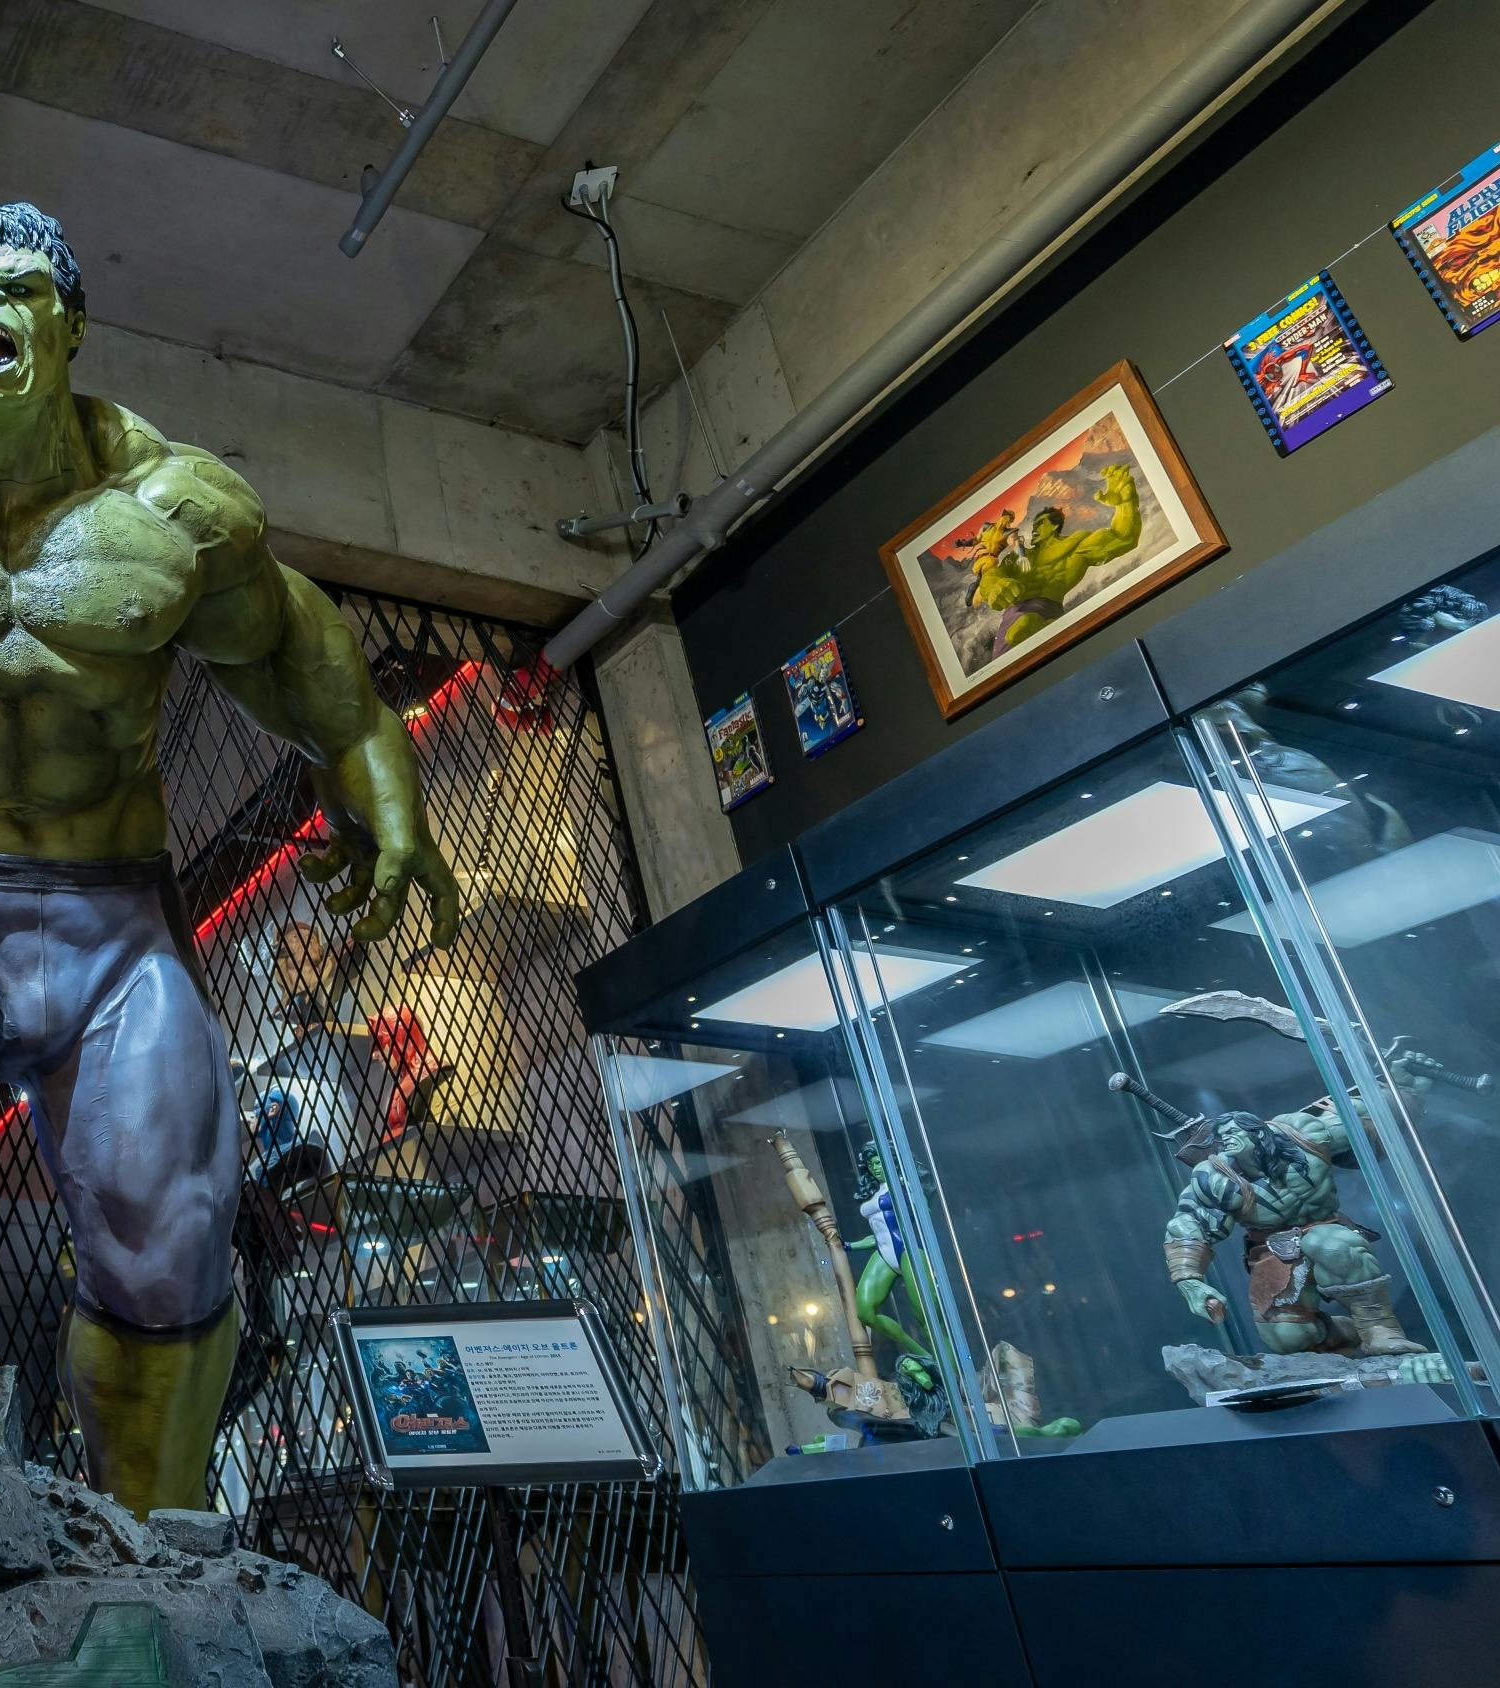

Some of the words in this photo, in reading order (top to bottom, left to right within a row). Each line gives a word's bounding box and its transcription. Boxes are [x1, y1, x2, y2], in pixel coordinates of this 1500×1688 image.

[1248, 341, 1257, 351] 3
[1256, 324, 1280, 345] FREE
[1280, 296, 1319, 329] COMICS!
[1282, 313, 1328, 348] SPIDER-MAN
[532, 1343, 548, 1351] 오브
